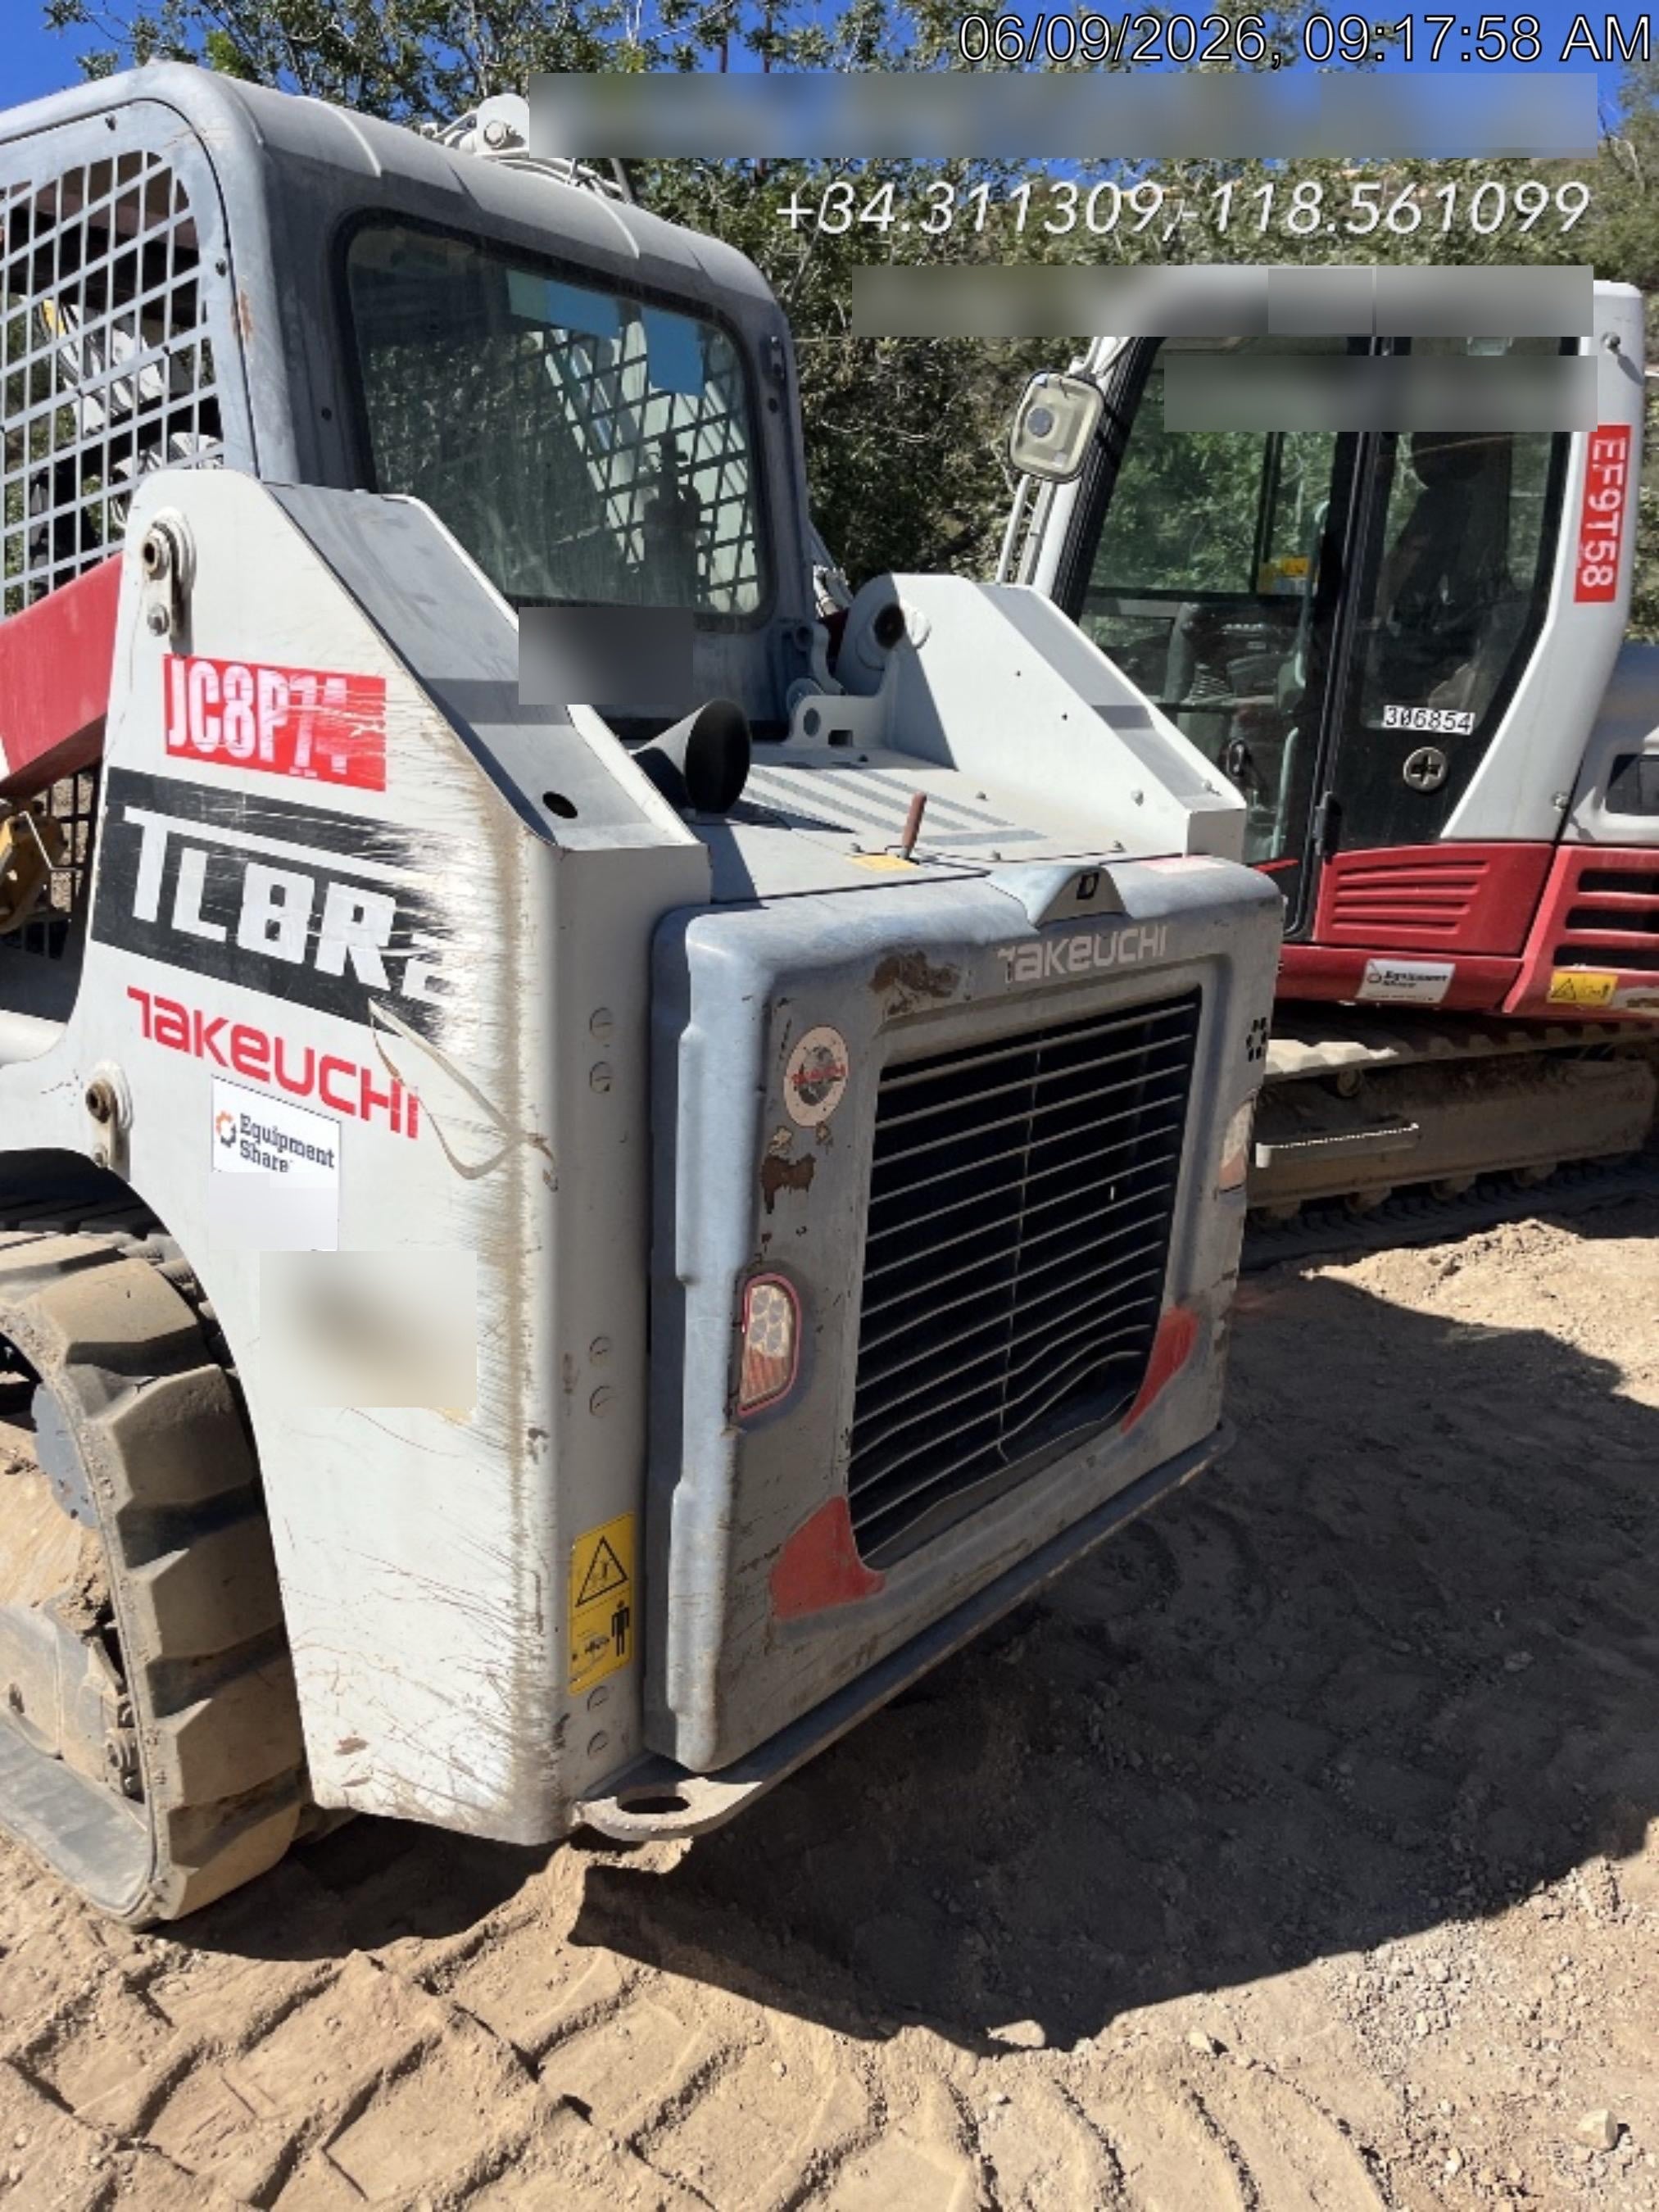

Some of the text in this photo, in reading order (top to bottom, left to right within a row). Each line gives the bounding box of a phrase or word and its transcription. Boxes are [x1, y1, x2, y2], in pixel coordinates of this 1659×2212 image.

[1581, 437, 1626, 588] EF9T58
[1385, 706, 1471, 732] 306854
[239, 1113, 335, 1169] Equipment
[239, 1139, 289, 1173] Share
